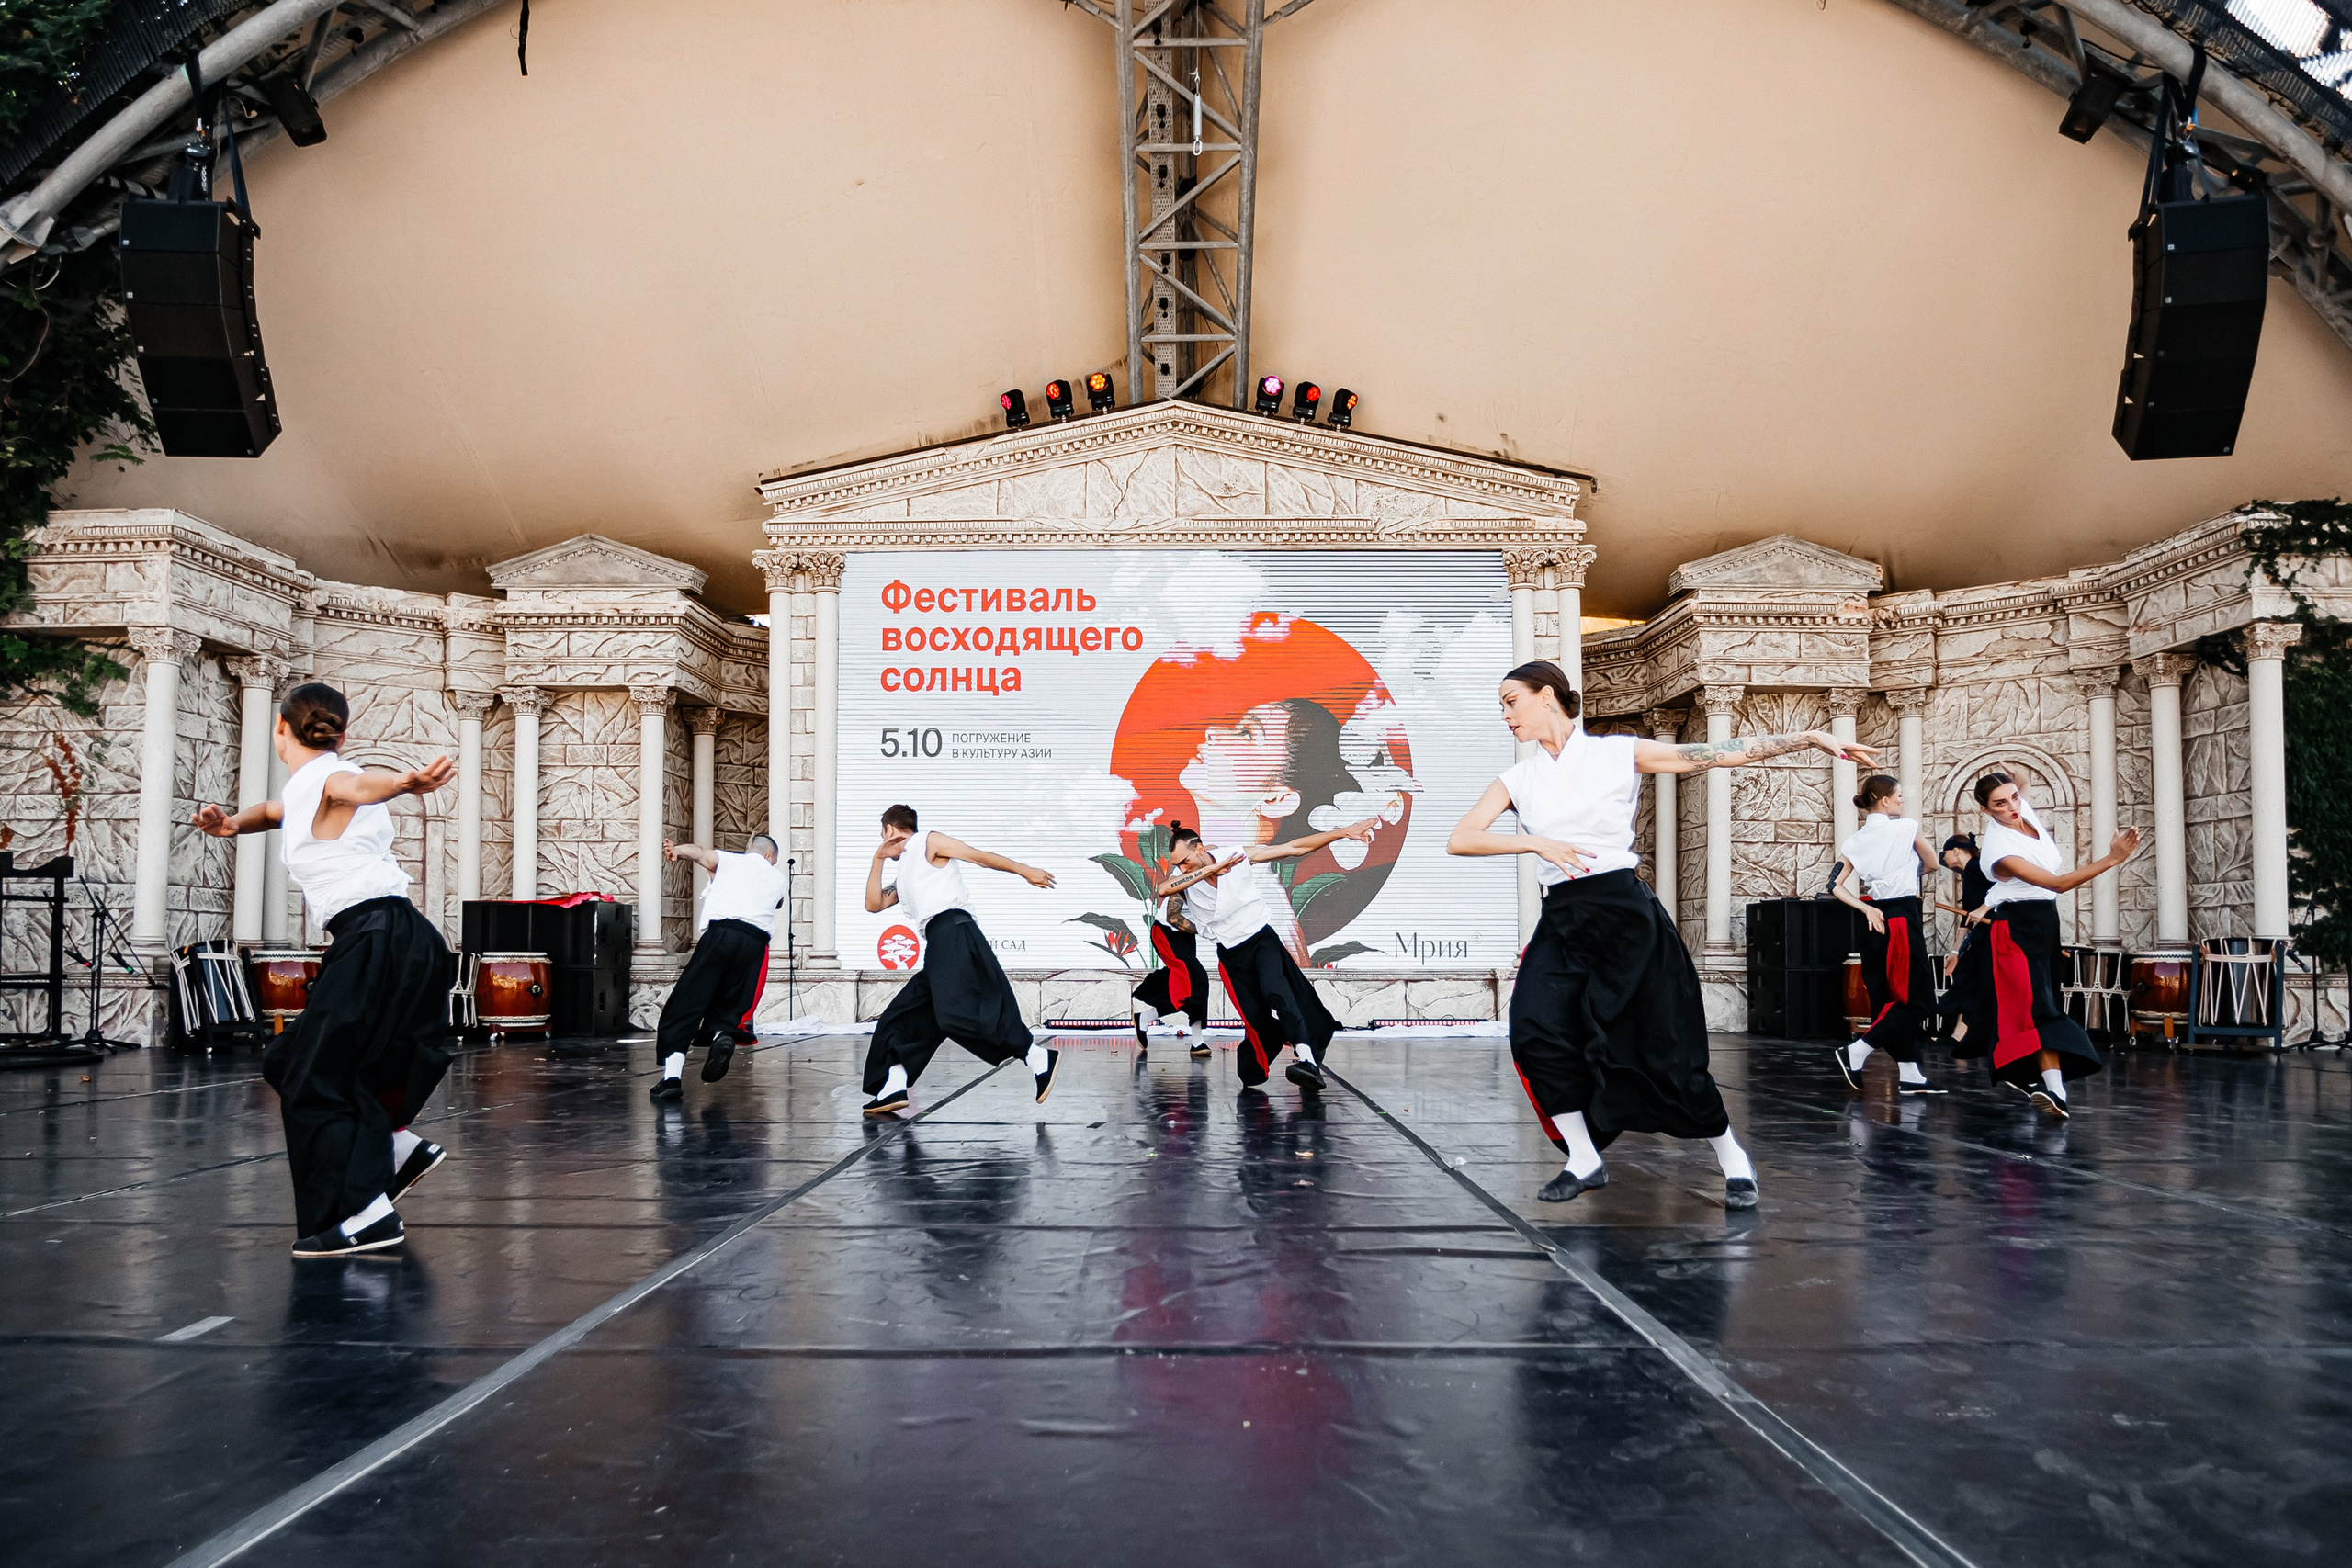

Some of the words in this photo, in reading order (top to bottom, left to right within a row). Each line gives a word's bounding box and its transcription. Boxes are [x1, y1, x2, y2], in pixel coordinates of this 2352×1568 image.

[881, 579, 1096, 614] Фестиваль
[882, 626, 1144, 656] восходящего
[880, 667, 1022, 696] солнца
[880, 728, 943, 758] 5.10
[952, 733, 1031, 743] ПОГРУЖЕНИЕ
[952, 749, 959, 758] В
[962, 749, 1018, 758] КУЛЬТУРУ
[1021, 749, 1052, 758] АЗИИ
[1001, 940, 1026, 952] САД
[1395, 931, 1468, 965] Мрия
